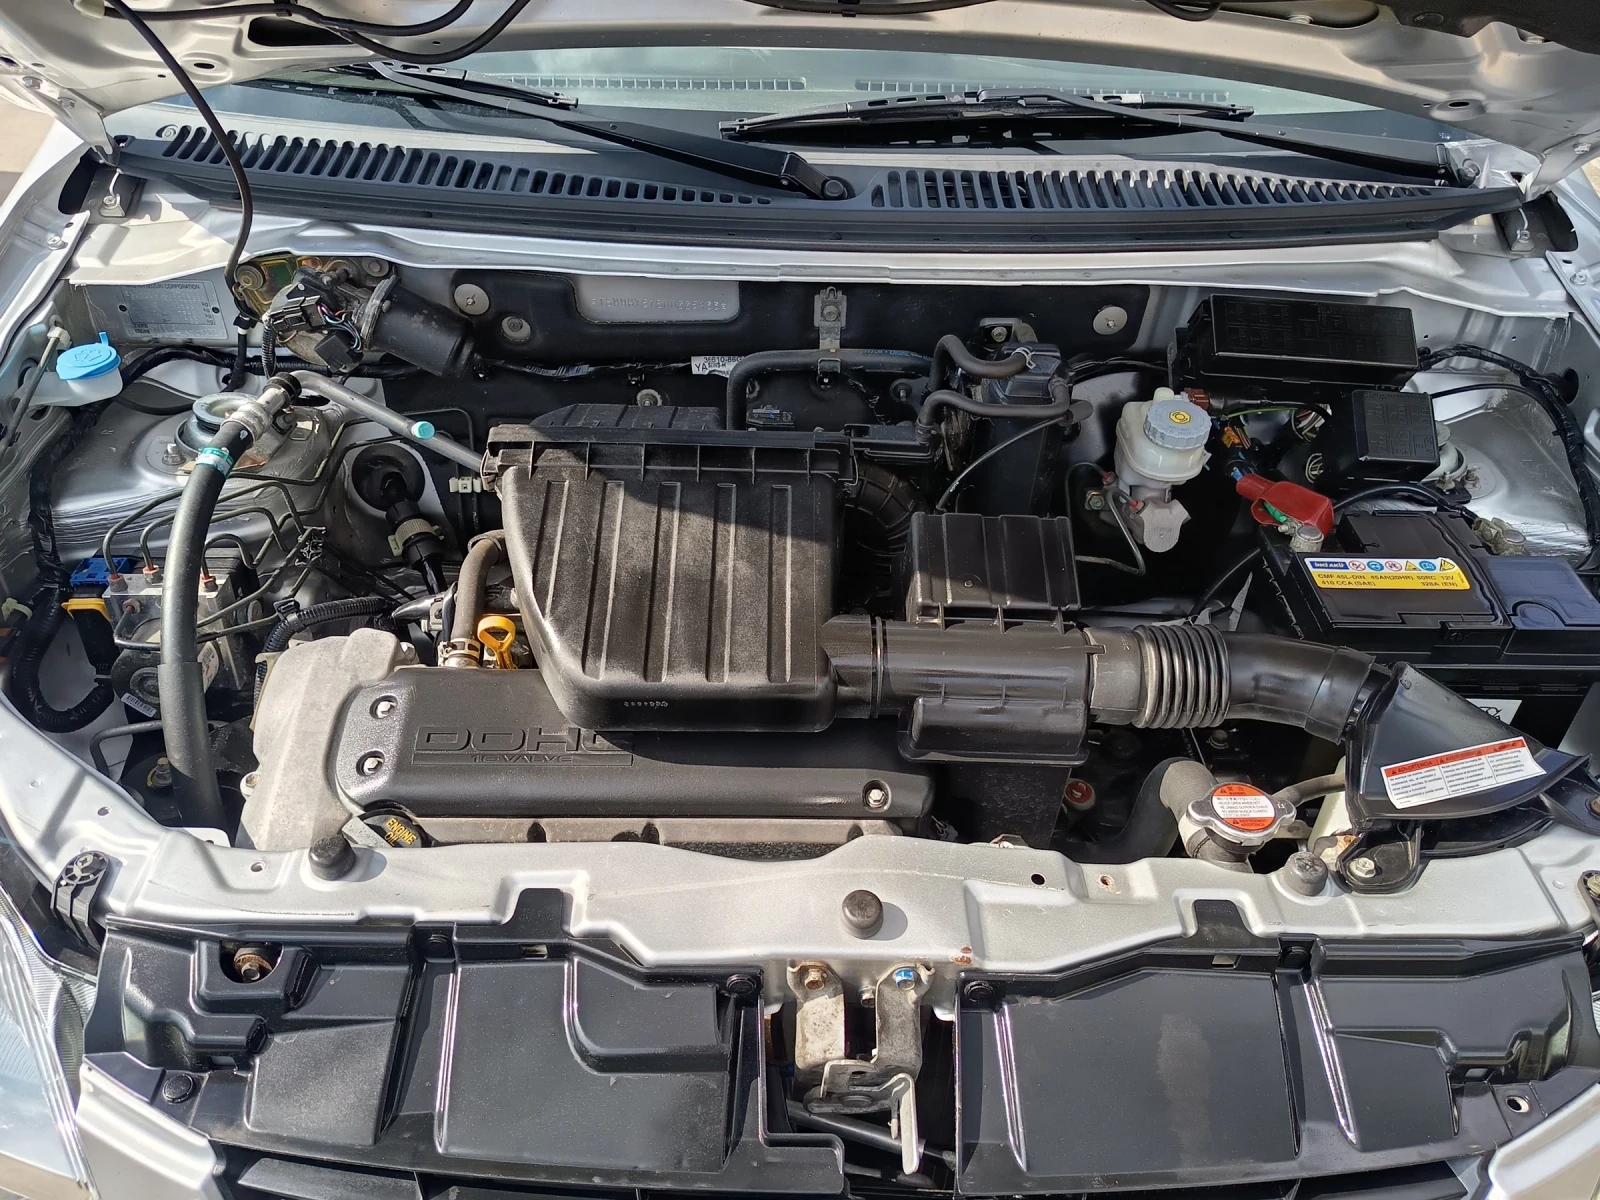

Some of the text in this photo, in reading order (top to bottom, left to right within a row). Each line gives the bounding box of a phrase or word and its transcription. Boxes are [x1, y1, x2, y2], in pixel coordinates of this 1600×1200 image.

[1398, 761, 1432, 772] ADVERTENCIA
[384, 831, 400, 847] OIL
[386, 817, 418, 846] ENGINE
